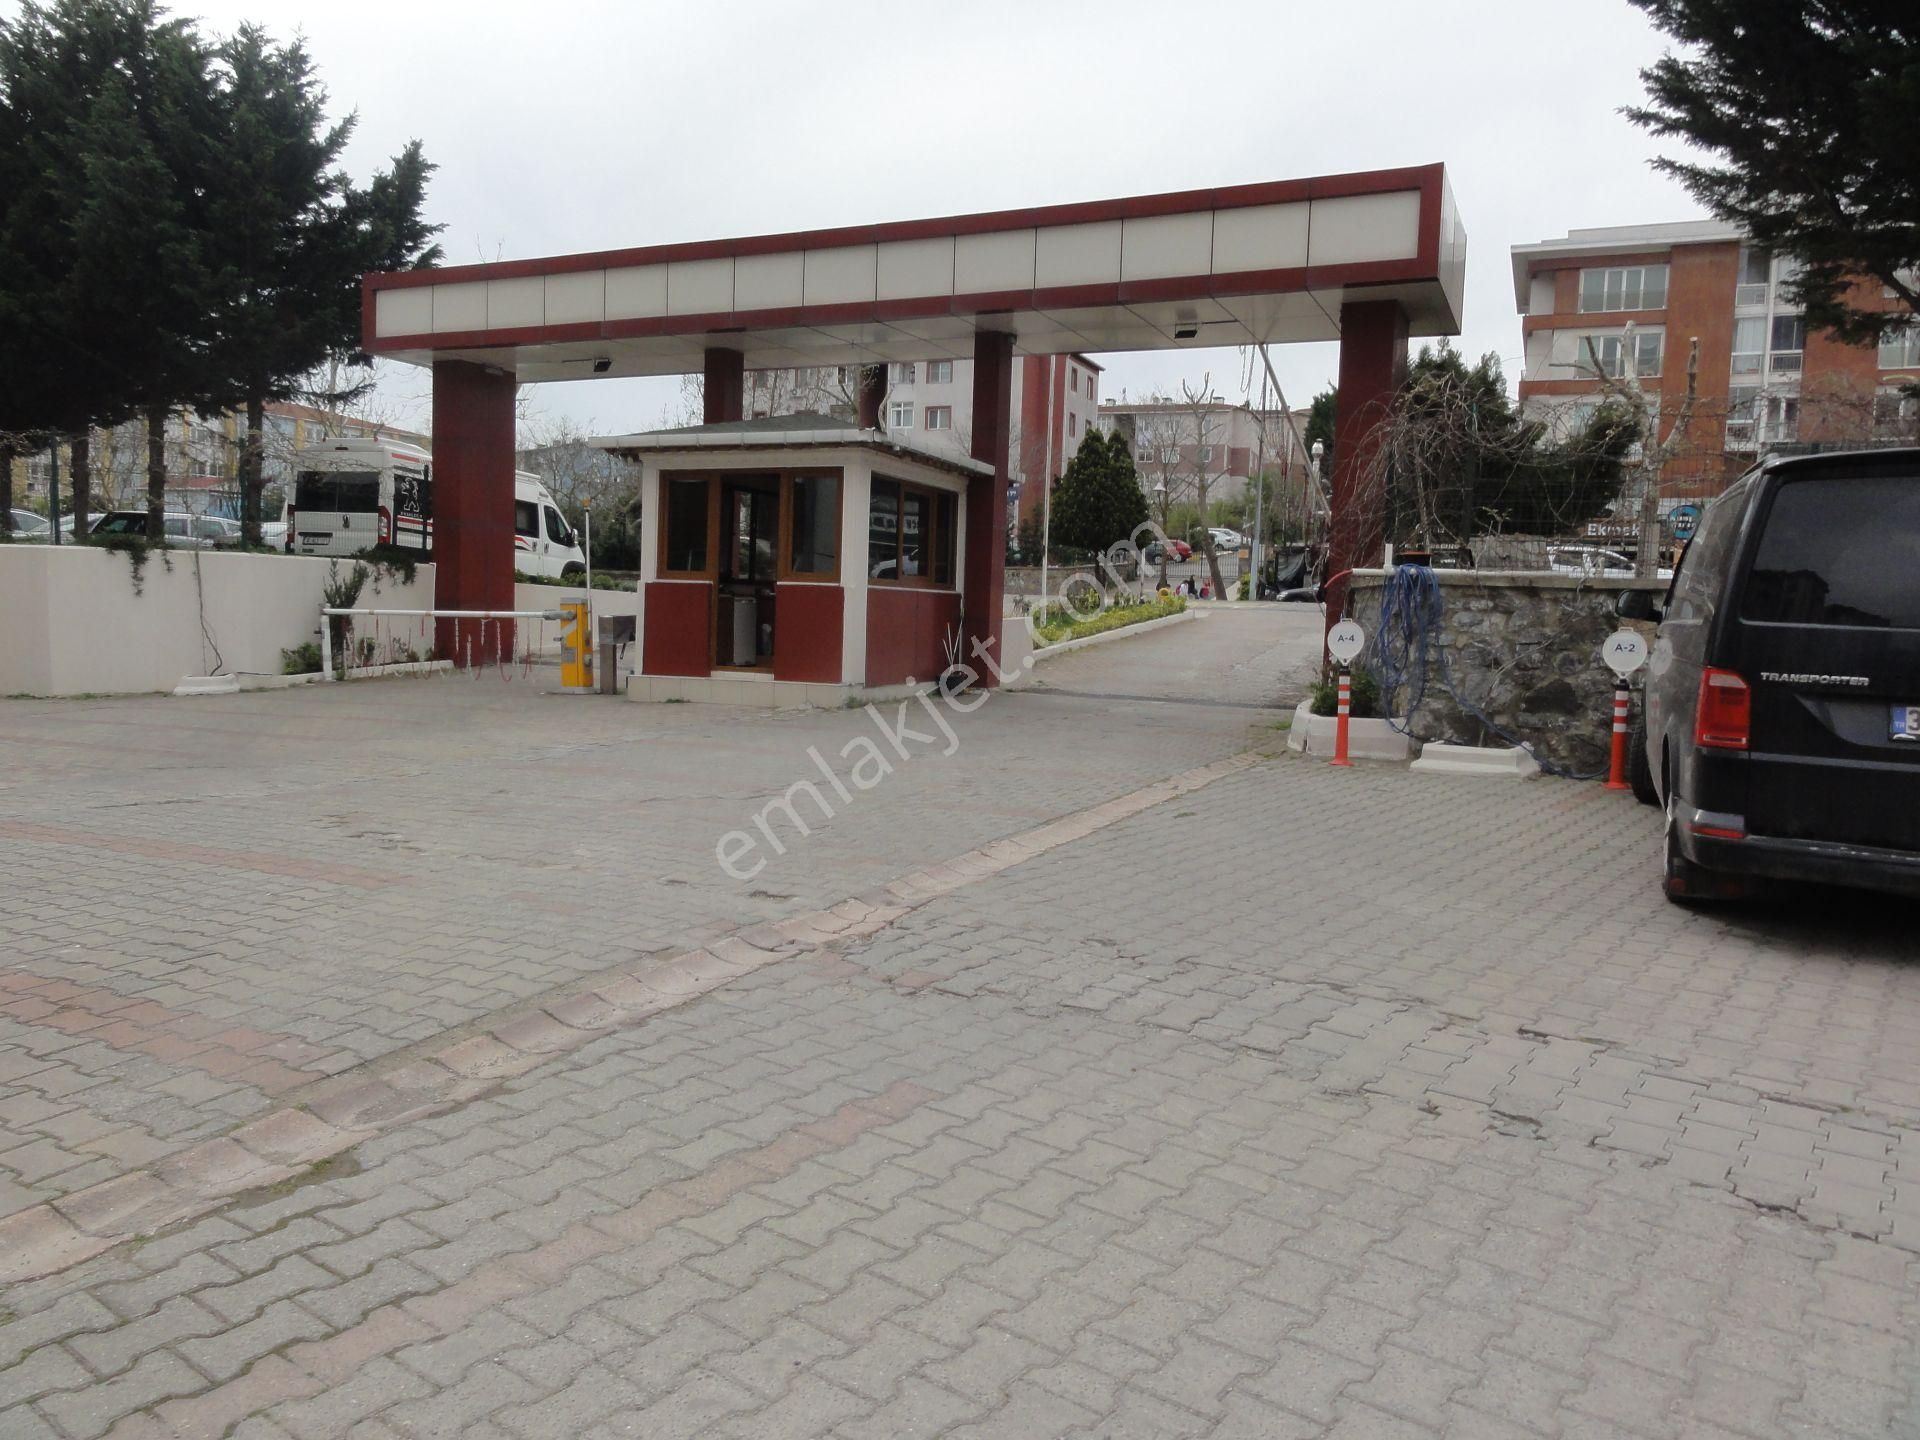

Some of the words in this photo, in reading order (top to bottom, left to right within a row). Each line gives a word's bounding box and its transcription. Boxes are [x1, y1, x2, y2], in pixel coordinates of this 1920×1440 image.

[1337, 634, 1355, 643] A-4
[1614, 643, 1636, 653] A-2
[1760, 671, 1871, 686] TRANSPORTER
